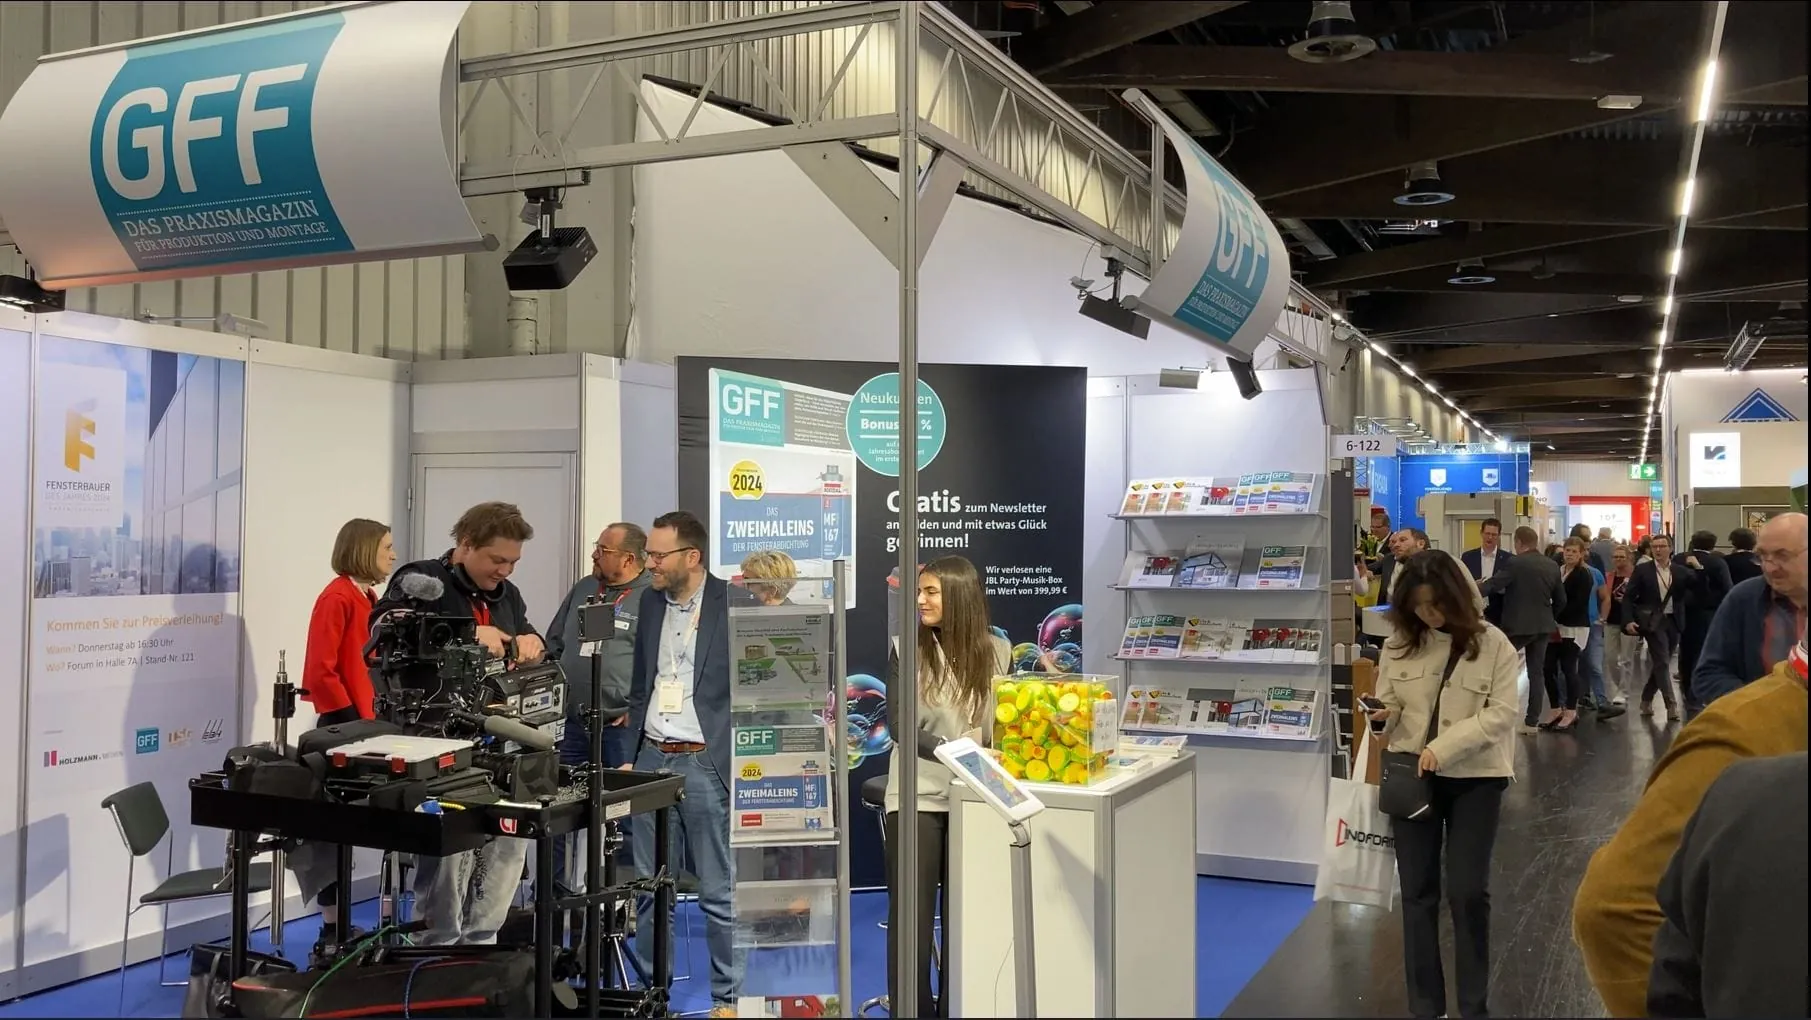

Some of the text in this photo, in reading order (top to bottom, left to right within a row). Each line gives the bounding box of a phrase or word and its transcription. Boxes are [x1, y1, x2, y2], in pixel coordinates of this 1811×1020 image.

[102, 63, 308, 200] GFF
[123, 200, 319, 237] DAS PRAXISMAGAZIN
[134, 222, 329, 253] FÜR PRODUKTION UND MONTAGE
[1215, 181, 1267, 288] GFF
[722, 383, 781, 419] GFF
[860, 392, 932, 404] Neukuen
[1346, 440, 1381, 451] 6-122
[46, 480, 110, 492] FENSTERBAUER
[733, 474, 762, 491] 2024
[887, 489, 1046, 513] Gatis zum Newsletter
[727, 519, 814, 538] ZWEIMALEINS
[886, 517, 1047, 530] anlden und mit etwas Glück
[824, 528, 838, 542] 167
[886, 533, 969, 552] geinnen!
[1000, 565, 1033, 574] verlosen
[985, 575, 1063, 586] JBL Party-Musik-Box
[985, 587, 996, 595] im
[998, 587, 1017, 595] Wert
[1034, 587, 1061, 597] 399,99
[47, 613, 223, 632] Kommen Sie zur Preisverleihung!
[78, 640, 124, 653] Donnerstag
[126, 640, 135, 650] ab
[137, 640, 159, 650] 16:30
[160, 638, 174, 648] Uhr
[67, 660, 94, 671] Forum
[96, 659, 103, 668] in
[105, 657, 126, 667] Halle
[127, 656, 138, 666] 7A
[181, 652, 194, 662] 121
[137, 733, 158, 747] GFF
[736, 730, 773, 745] GFF
[742, 768, 762, 777] 2024
[738, 787, 798, 799] ZWEIMALEINS
